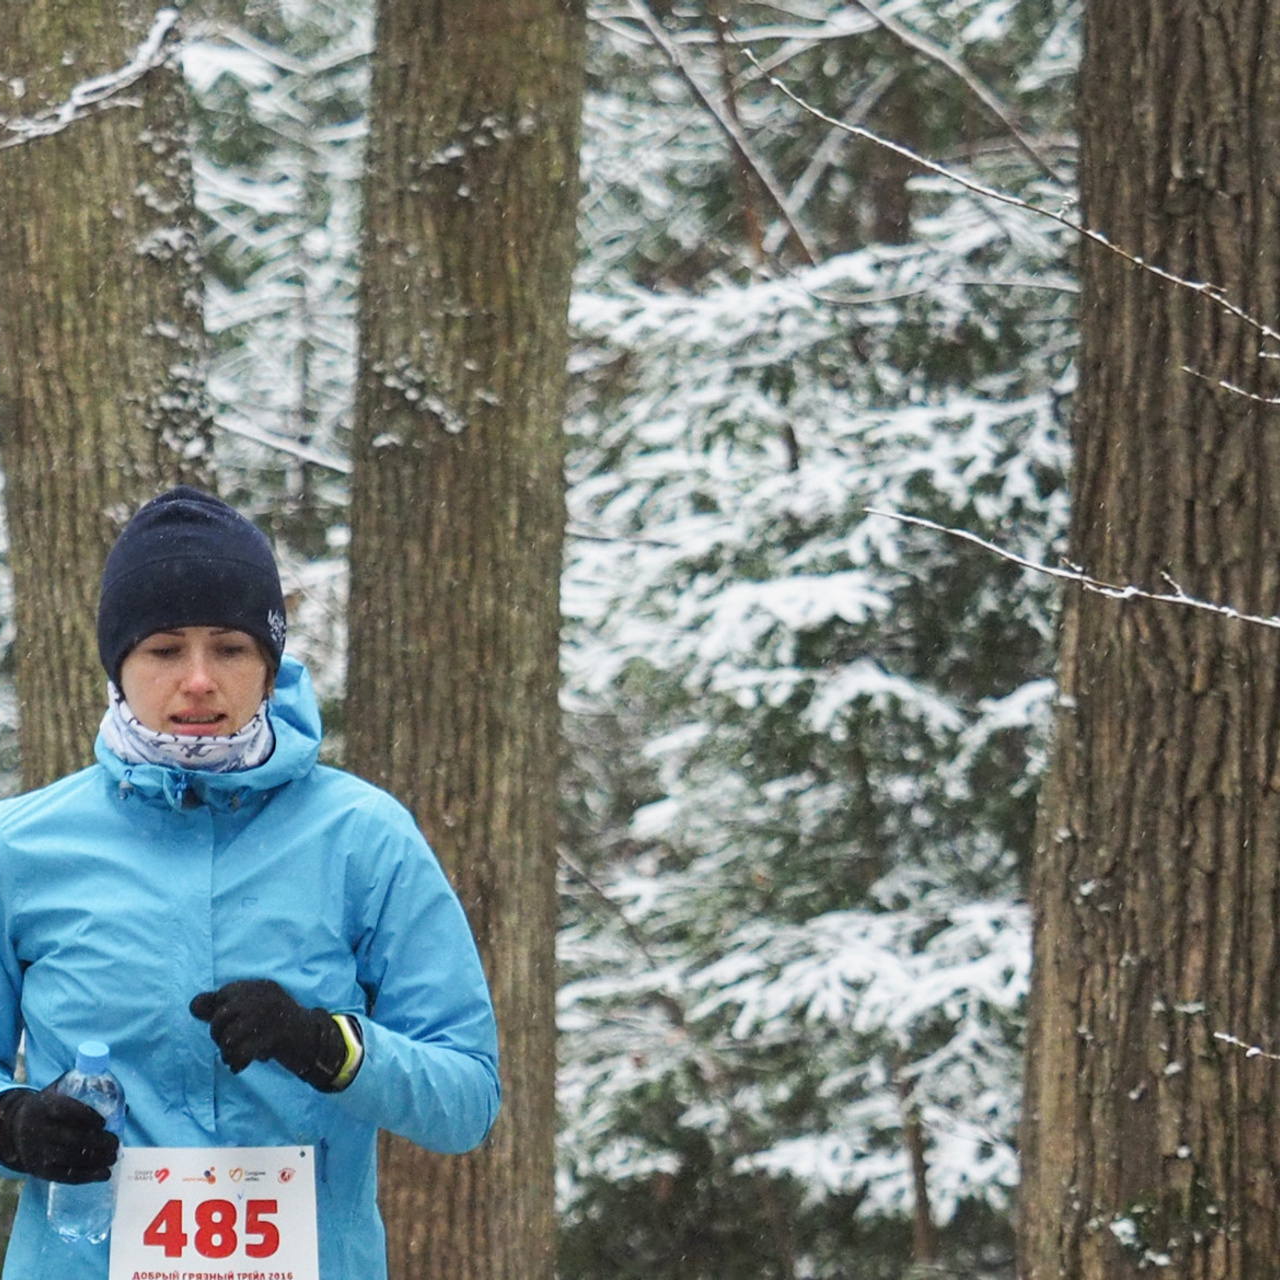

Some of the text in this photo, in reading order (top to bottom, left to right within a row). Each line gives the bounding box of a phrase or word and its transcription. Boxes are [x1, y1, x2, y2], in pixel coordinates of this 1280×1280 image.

[143, 1199, 280, 1259] 485
[132, 1270, 293, 1280] ДОБРЫЙ ГРЯЗНЫЙ ТРЕЙЛ 2016
